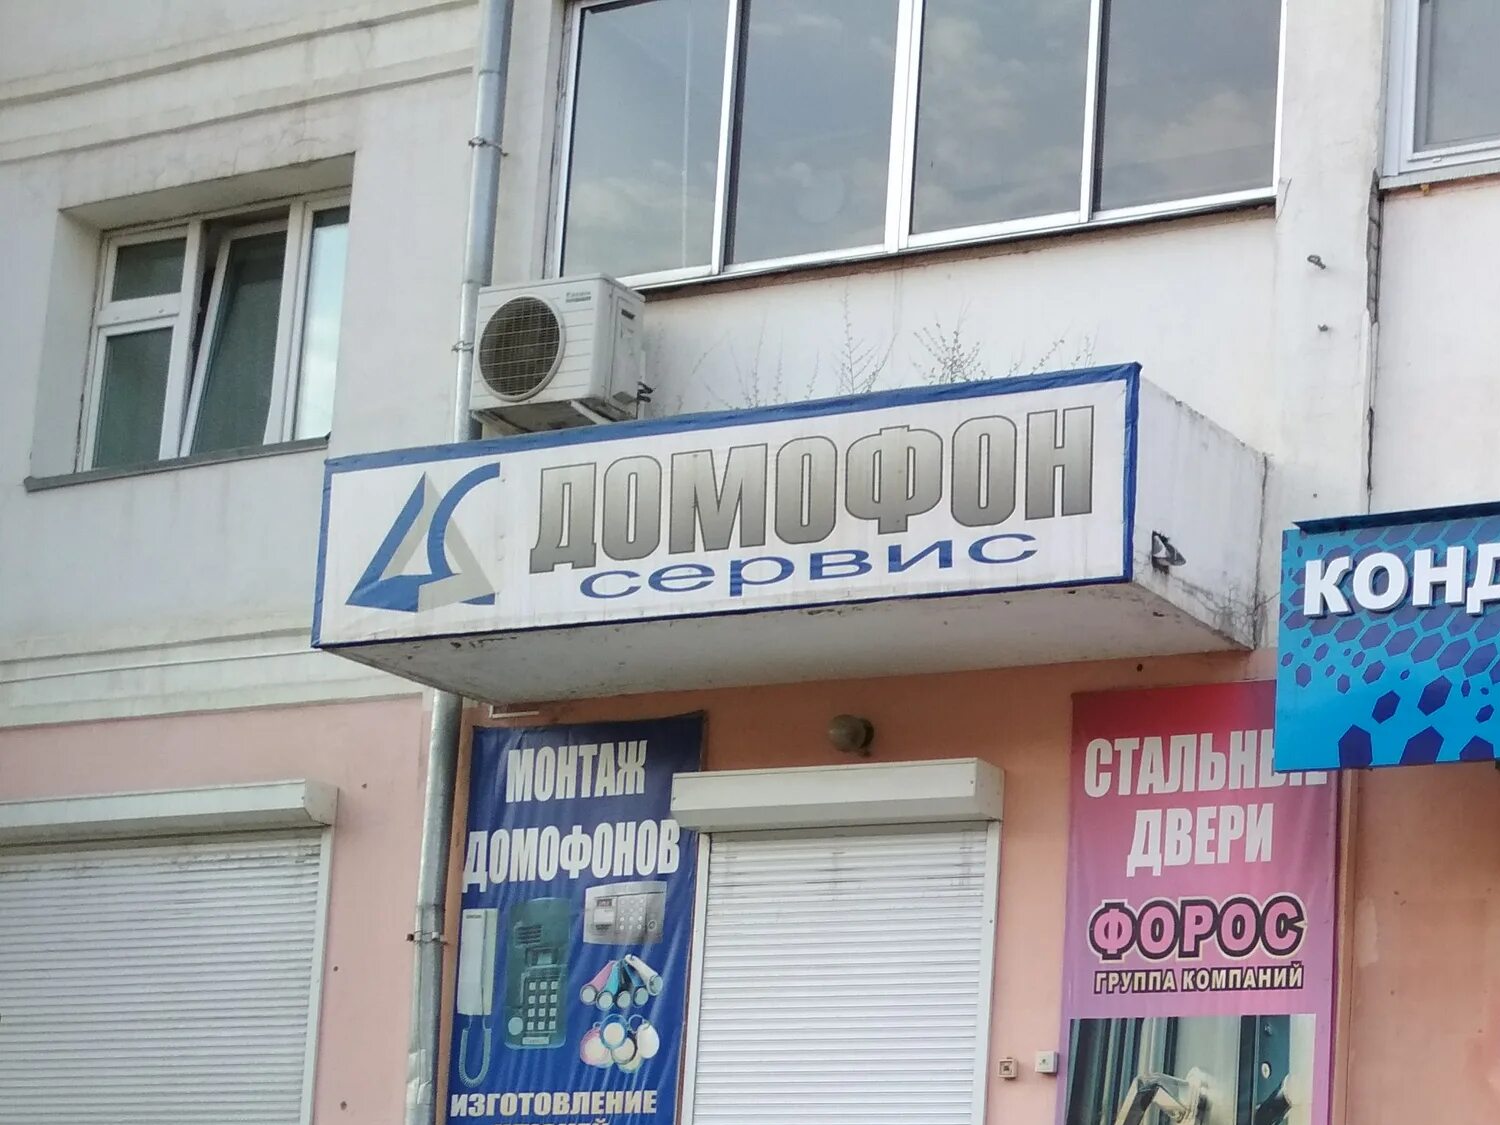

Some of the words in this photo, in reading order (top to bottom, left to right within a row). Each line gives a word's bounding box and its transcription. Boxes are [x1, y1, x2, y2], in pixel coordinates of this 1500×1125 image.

[529, 404, 1095, 575] ДОМОФОН
[579, 532, 1038, 600] сервис
[505, 739, 648, 803] МОНТАЖ
[461, 818, 681, 893] ДОМОФОНОВ
[1126, 802, 1275, 877] ДВЕРИ
[1089, 893, 1307, 963] ФОРОС
[1094, 967, 1177, 994] ГРУППА
[1180, 960, 1304, 992] КОМПАНИЙ
[450, 1090, 657, 1117] ИЗГОТОВЛЕНИЕ
